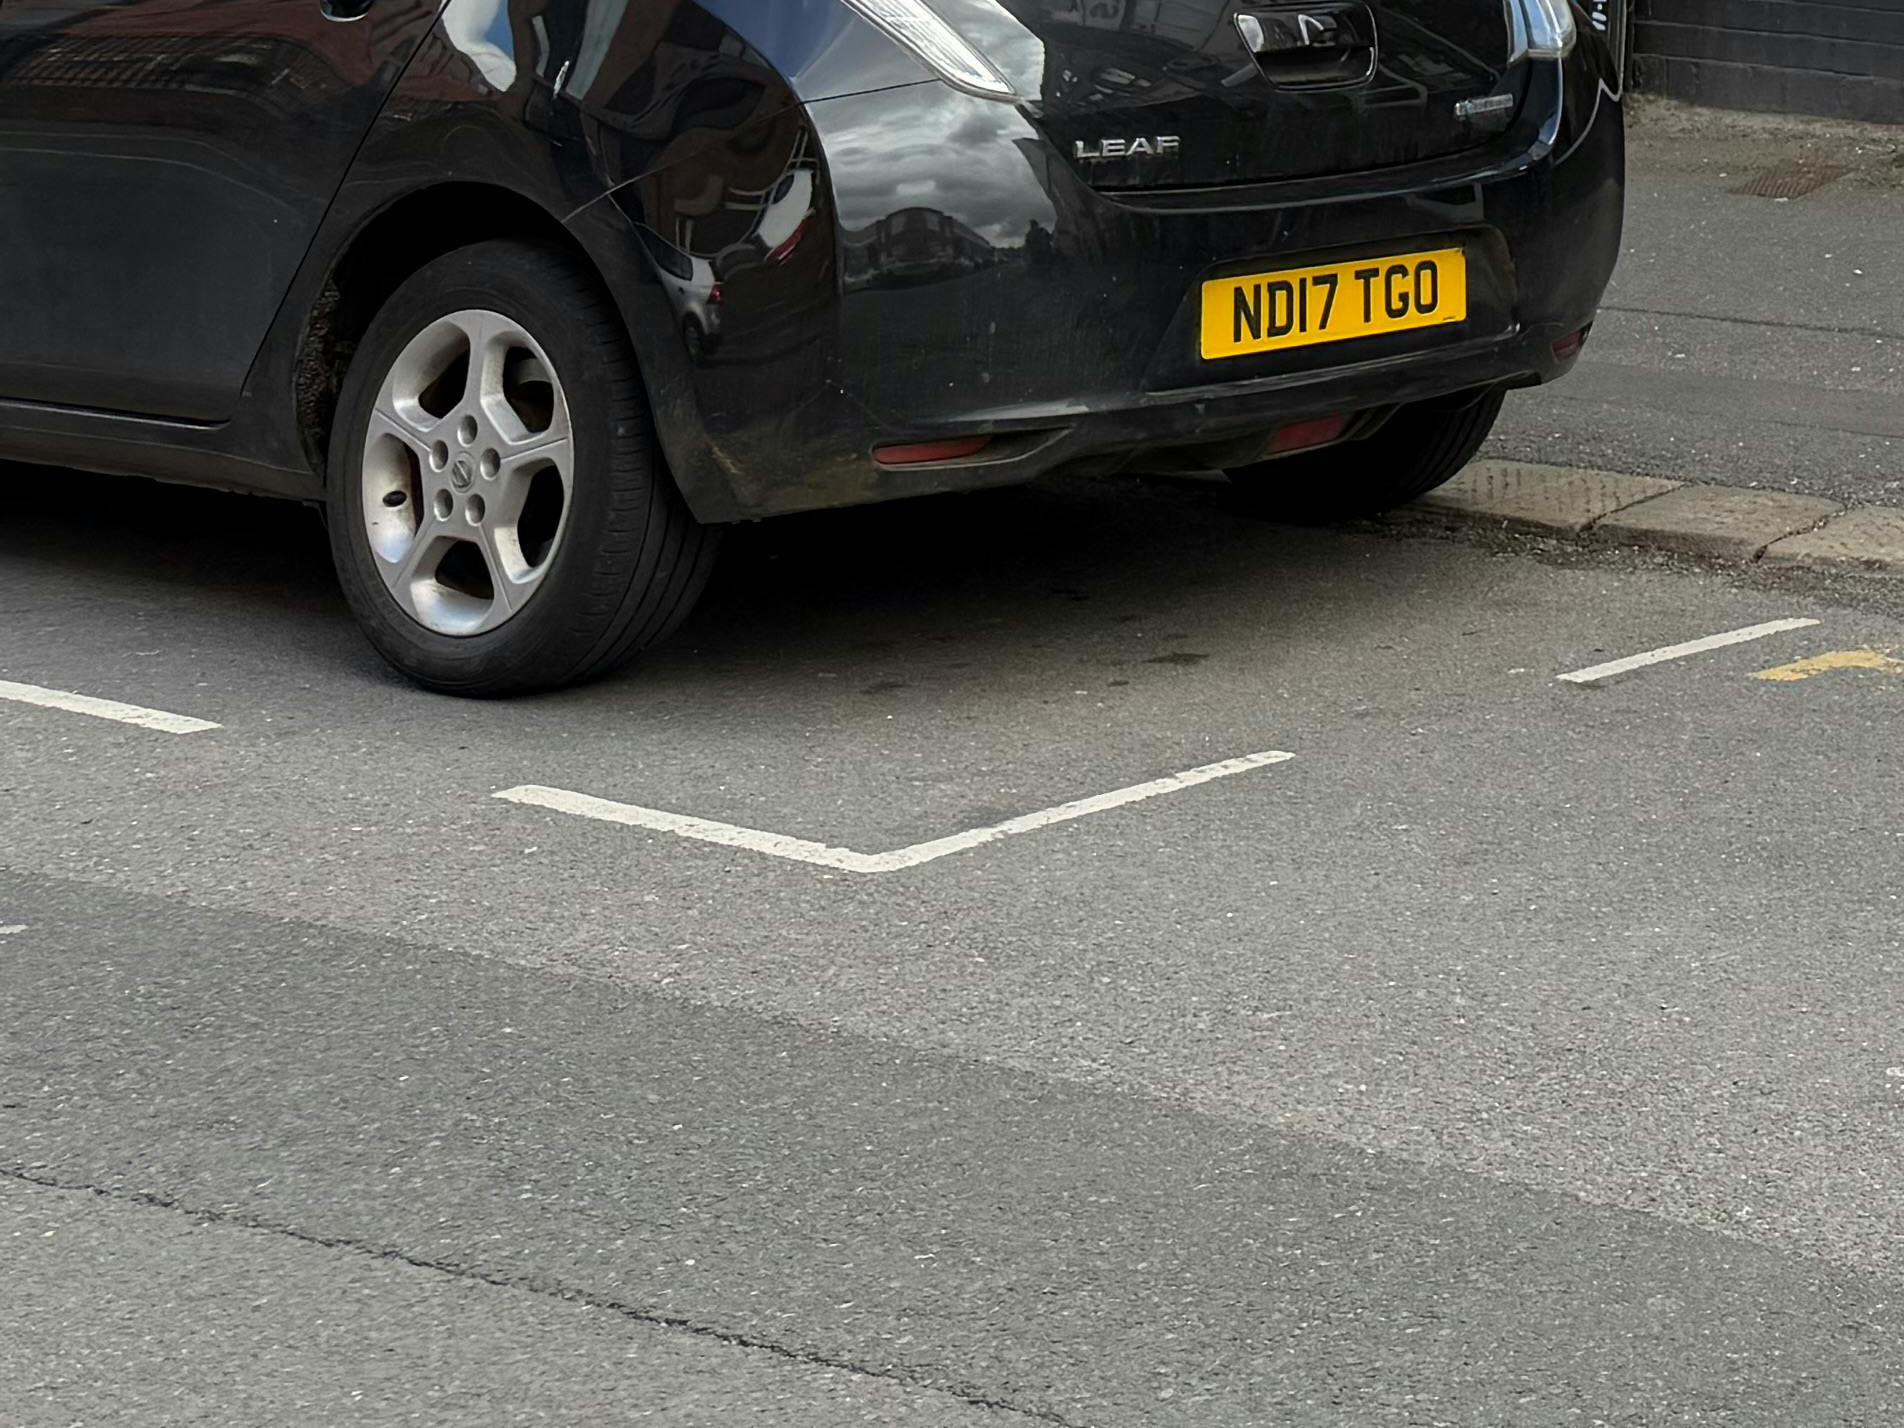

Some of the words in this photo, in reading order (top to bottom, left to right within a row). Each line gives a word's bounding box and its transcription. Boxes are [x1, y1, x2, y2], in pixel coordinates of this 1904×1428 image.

[1075, 135, 1181, 159] LEAF
[1232, 272, 1338, 344] ND17
[1354, 260, 1438, 324] TGO
